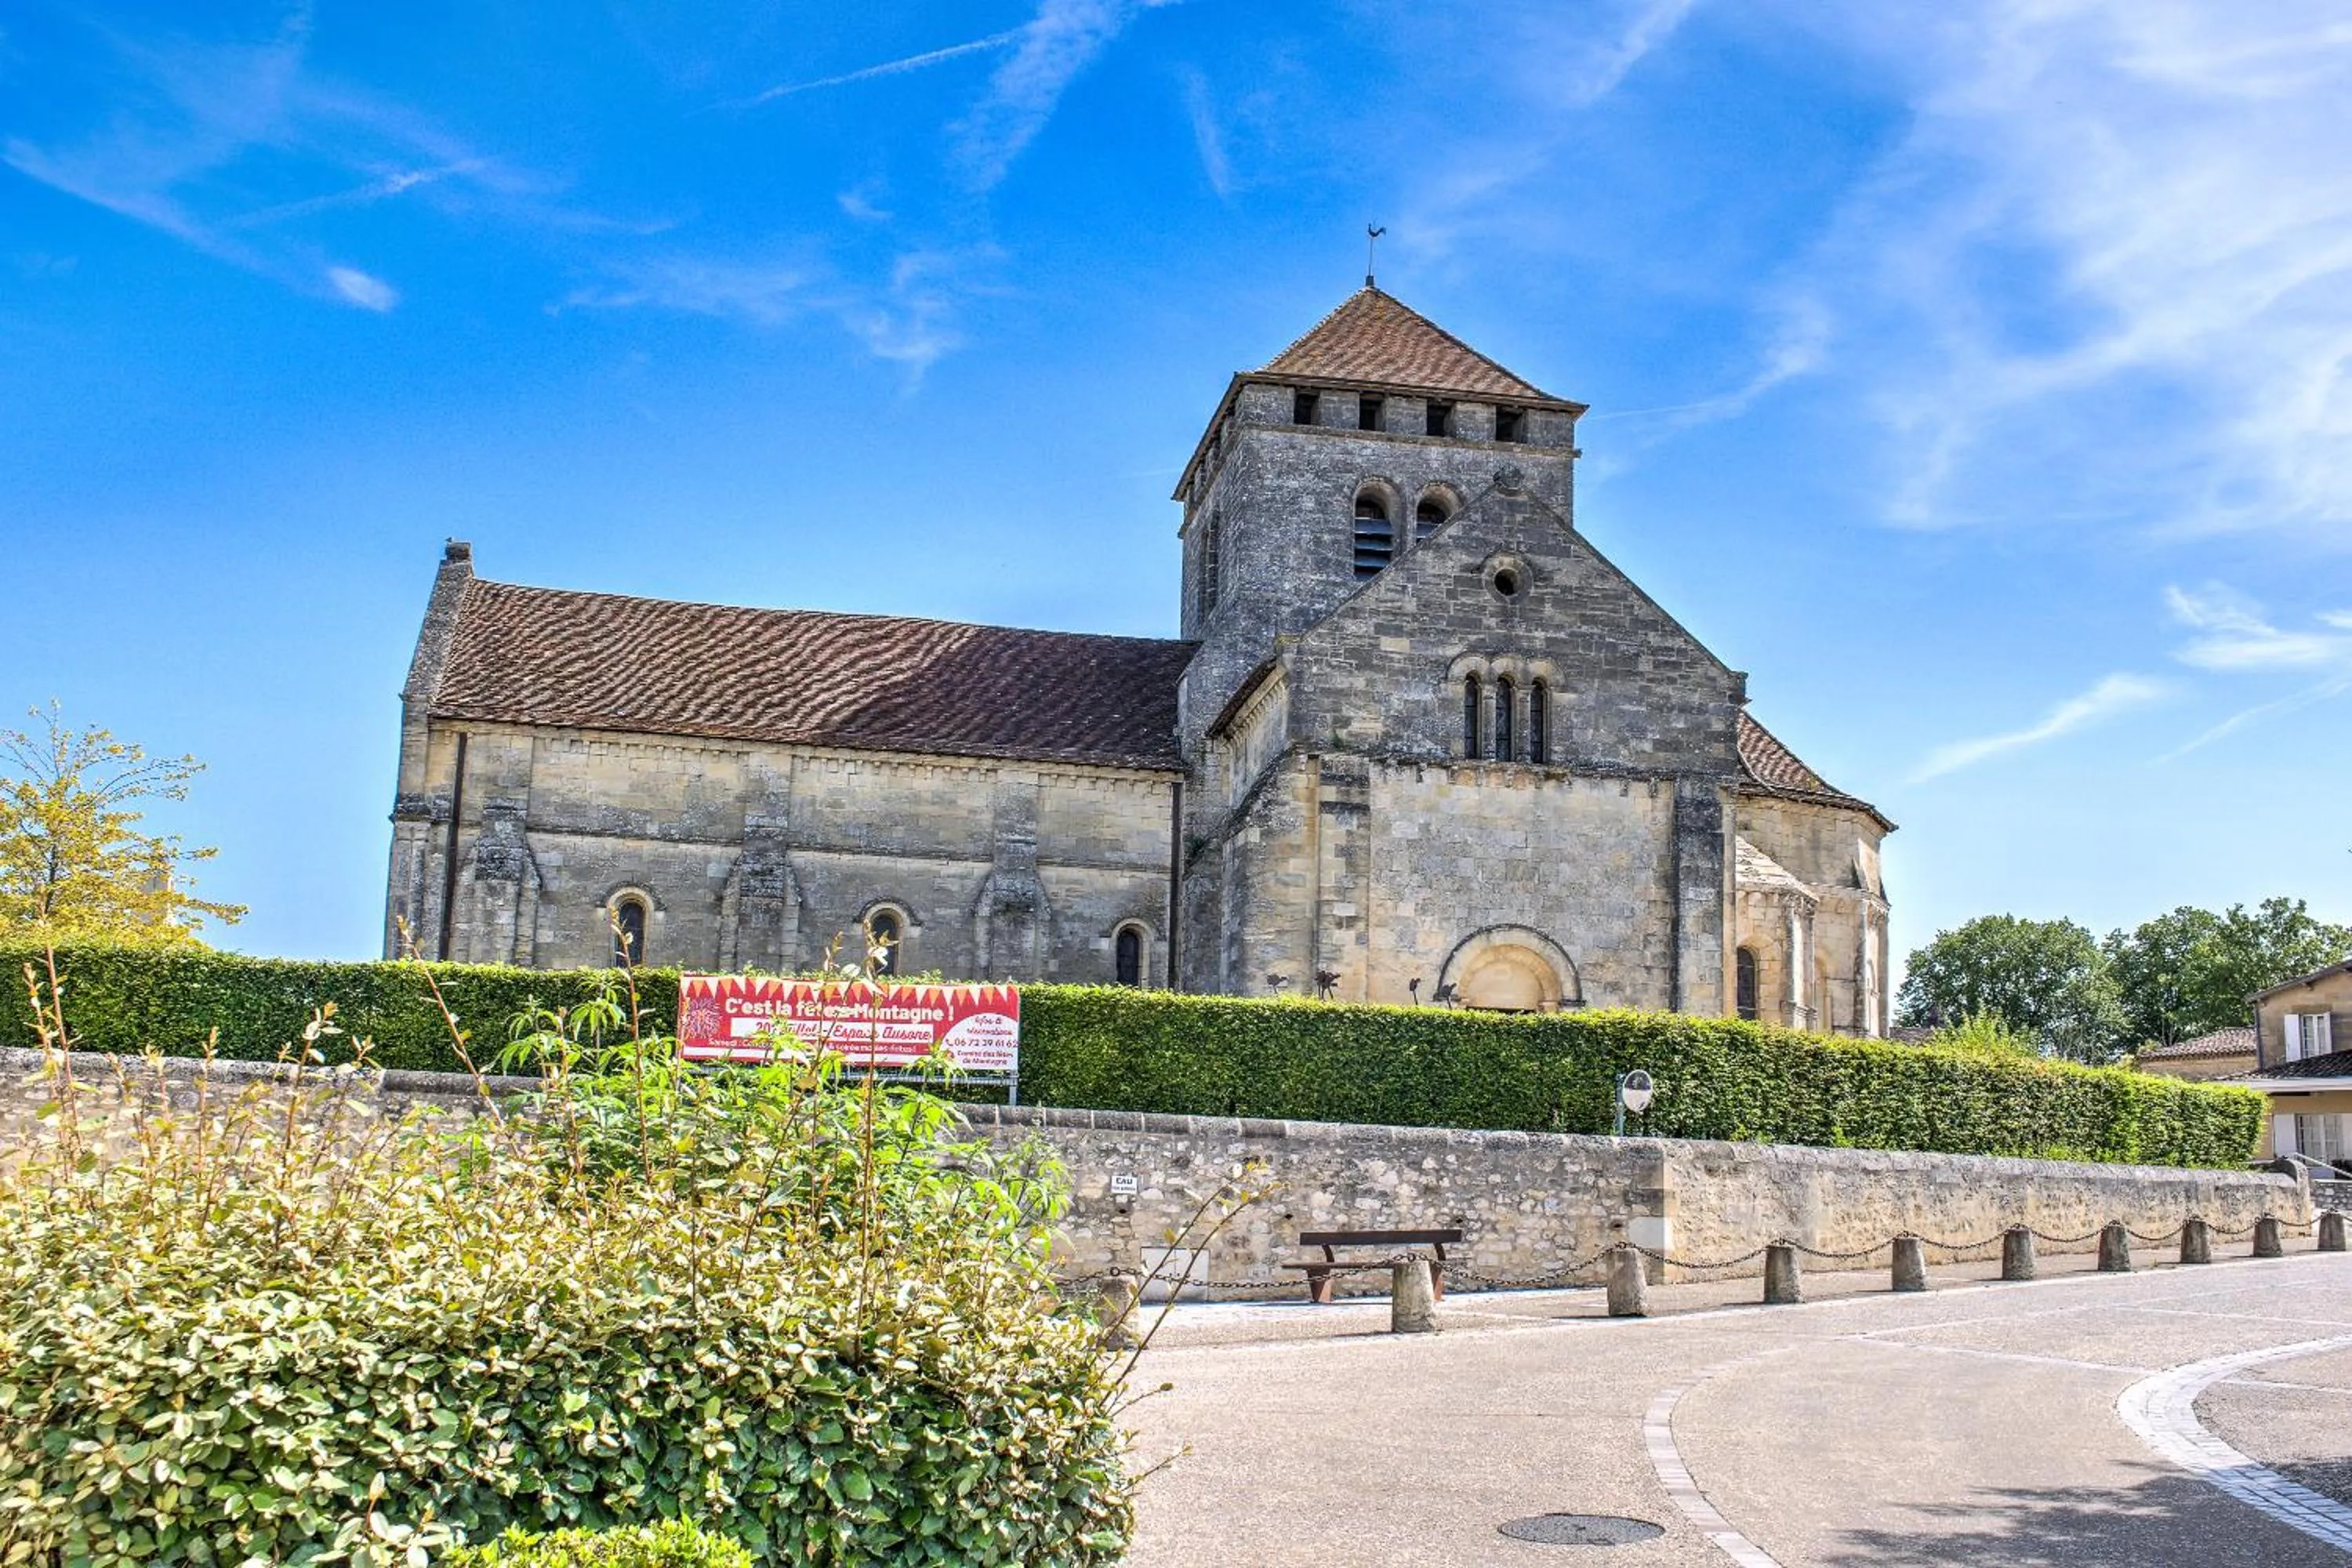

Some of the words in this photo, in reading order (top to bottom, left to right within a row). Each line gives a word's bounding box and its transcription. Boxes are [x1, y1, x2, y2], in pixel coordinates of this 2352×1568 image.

[725, 997, 772, 1015] C'est
[775, 1000, 793, 1017] la
[948, 1006, 954, 1021] !
